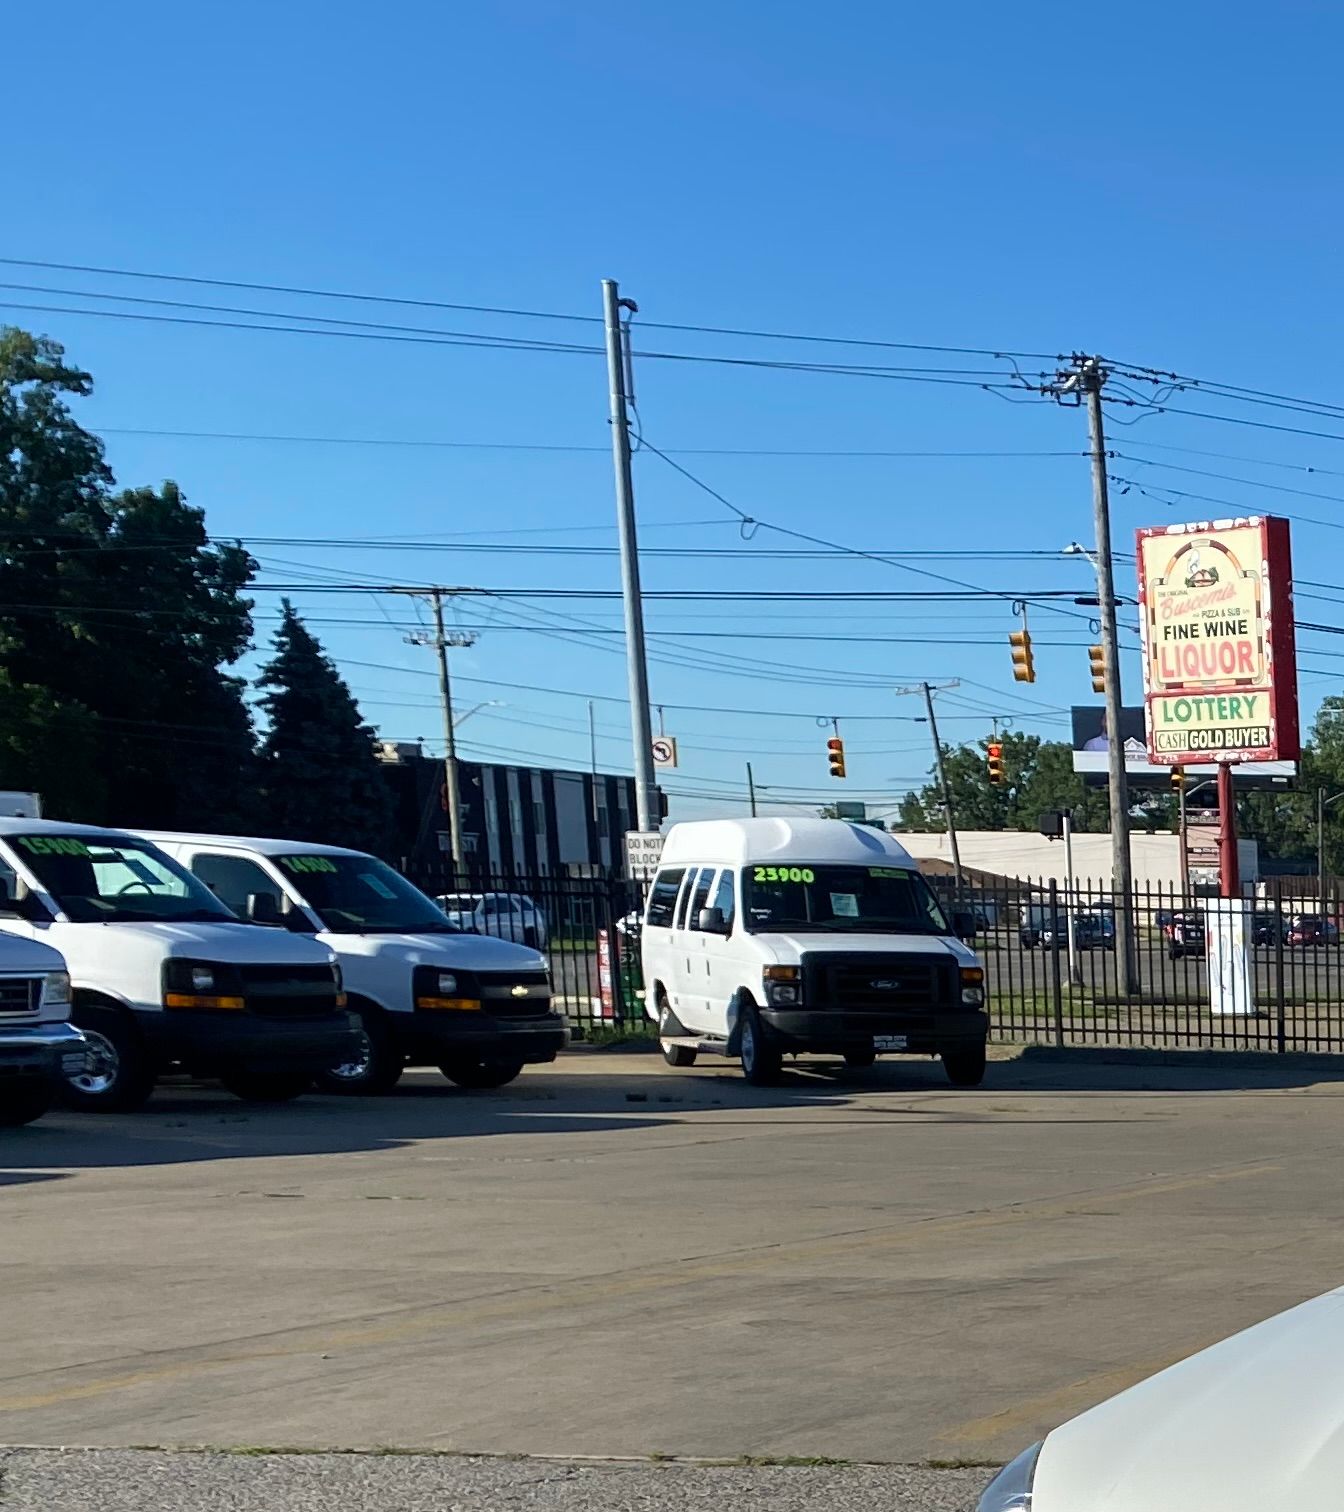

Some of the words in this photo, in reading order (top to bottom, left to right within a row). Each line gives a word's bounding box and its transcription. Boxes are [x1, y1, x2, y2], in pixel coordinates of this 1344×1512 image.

[1201, 609, 1220, 618] PIZZA
[1227, 607, 1241, 617] SUB
[1163, 623, 1200, 641] FINE
[1203, 619, 1248, 638] WINE
[1161, 640, 1255, 678] LIQUOR
[1162, 695, 1258, 723] LOTTERY
[1158, 732, 1187, 749] CASH
[1189, 729, 1224, 749] GOLD
[1225, 727, 1268, 748] BUYER
[628, 838, 641, 849] DO
[643, 838, 661, 849] NOT
[753, 866, 815, 883] 23900
